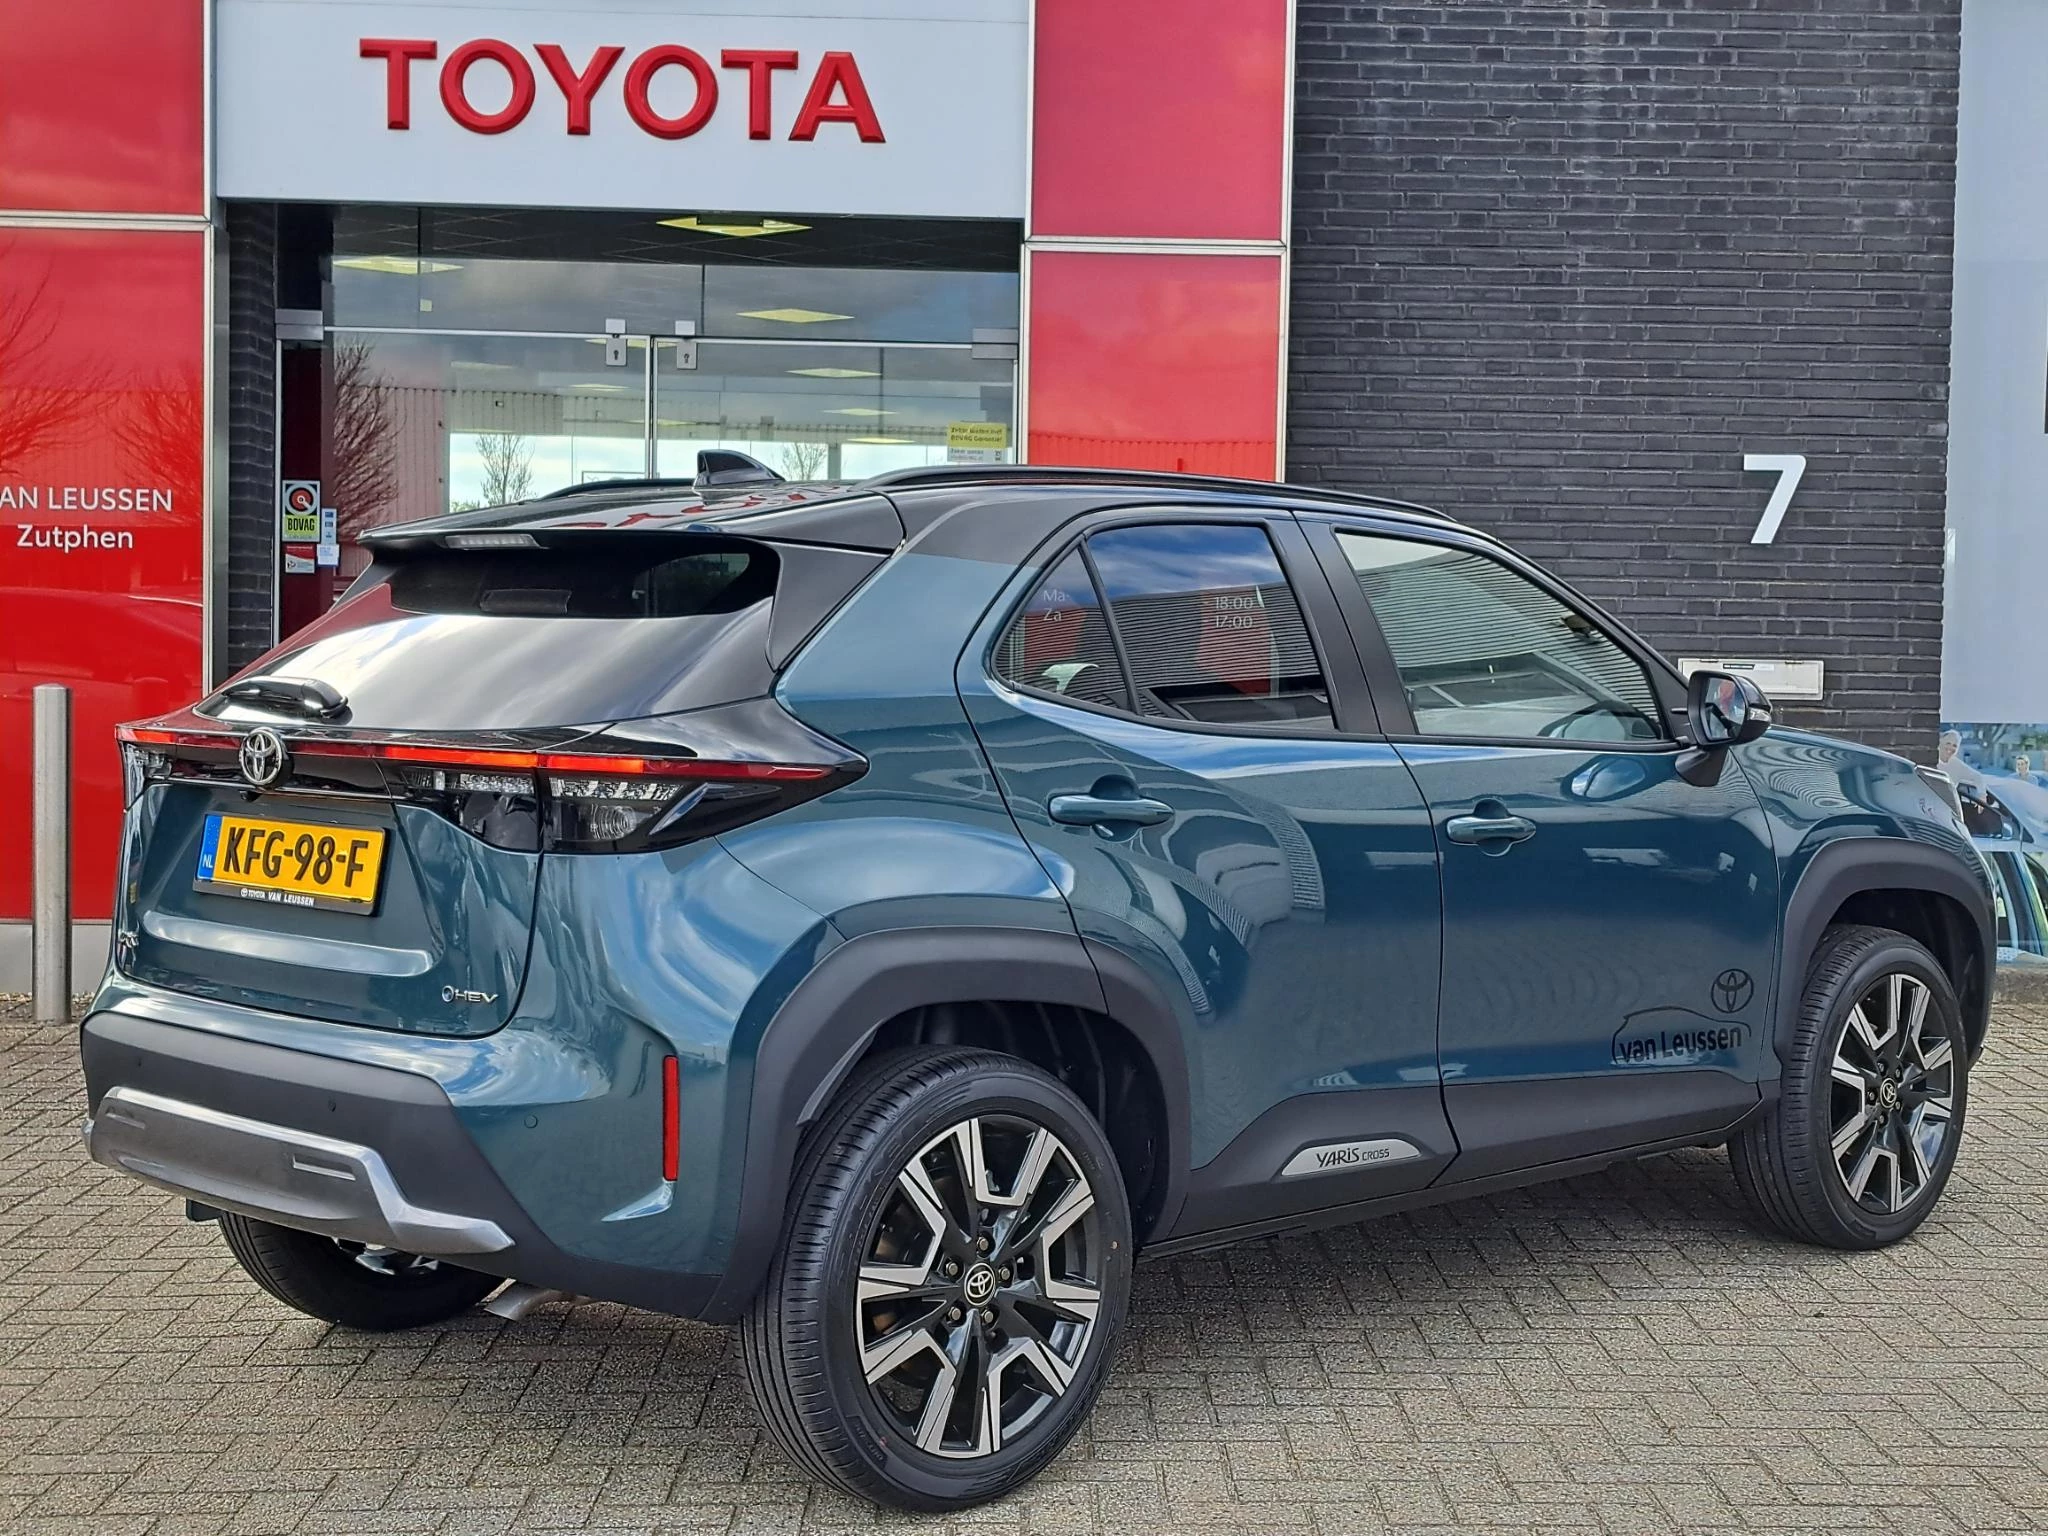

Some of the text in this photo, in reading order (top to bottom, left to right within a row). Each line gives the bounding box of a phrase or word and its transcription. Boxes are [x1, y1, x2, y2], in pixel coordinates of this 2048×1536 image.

[360, 39, 884, 142] TOYOTA
[0, 486, 173, 513] AN LEUSSEN
[1743, 454, 1807, 544] 7
[287, 518, 316, 532] BOVAG
[16, 523, 134, 554] Zutphen
[1043, 607, 1063, 622] Za
[202, 855, 214, 869] NL
[222, 826, 370, 888] KFG-98-F
[248, 889, 316, 907] TOYOTA VAN LEUSSEN
[455, 988, 499, 1003] HEV
[1618, 1026, 1743, 1064] van Leussen
[1316, 1147, 1391, 1168] YARIS CROSS
